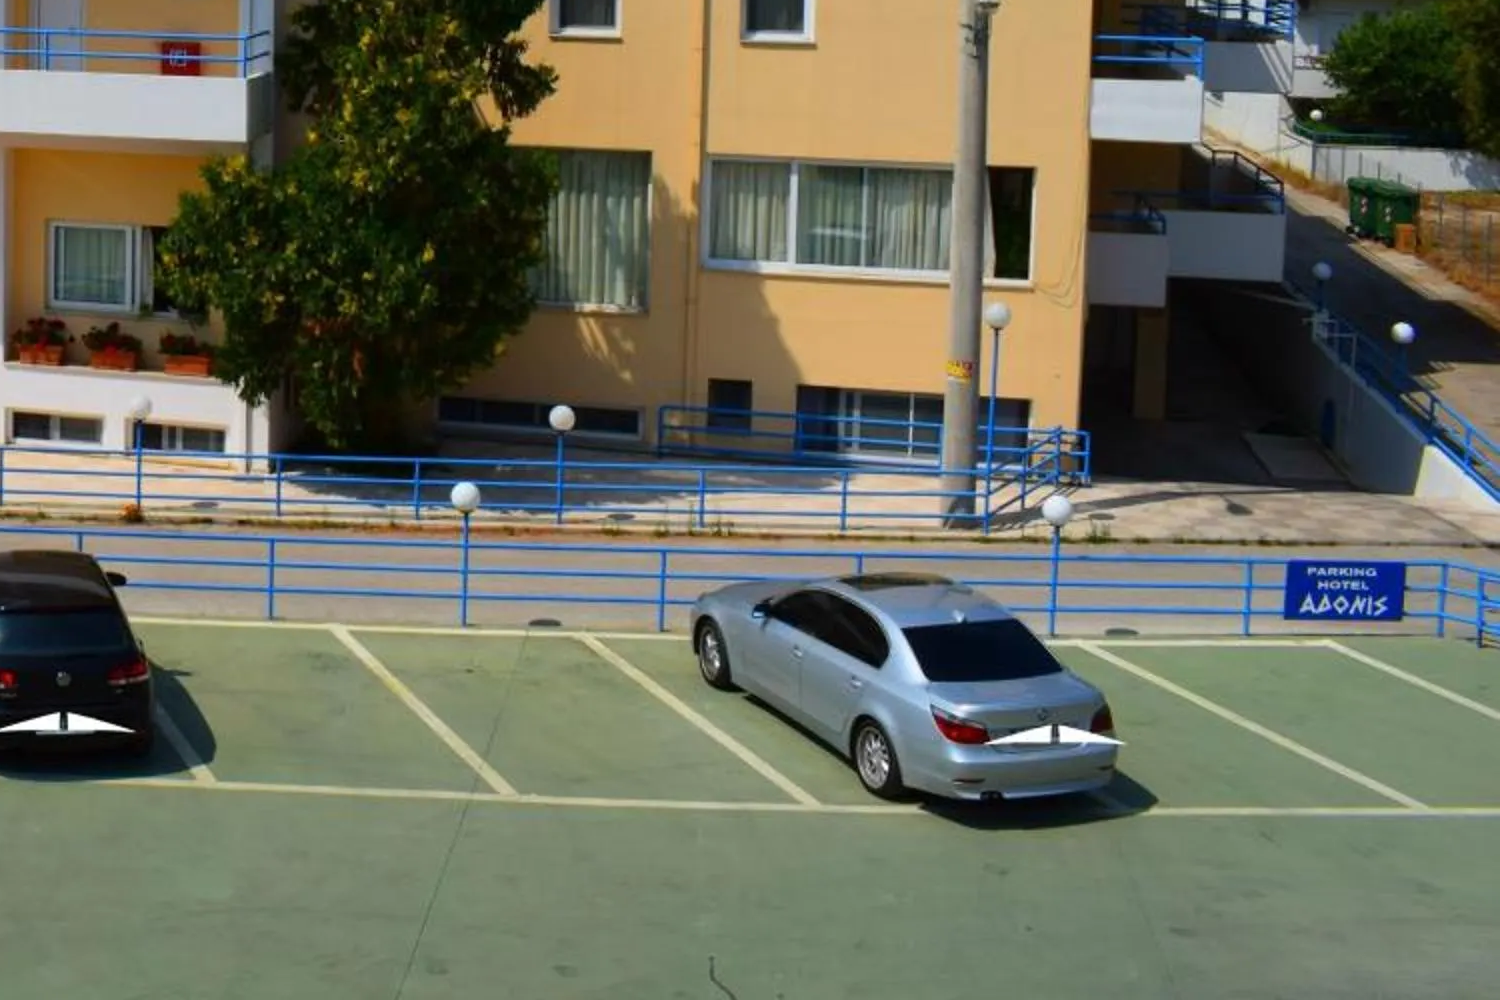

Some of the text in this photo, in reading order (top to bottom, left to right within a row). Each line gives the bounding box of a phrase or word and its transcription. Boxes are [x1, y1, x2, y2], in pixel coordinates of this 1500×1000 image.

[1307, 567, 1377, 577] PARKING
[1316, 580, 1370, 591] HOTEL
[1300, 592, 1389, 616] ADONIS
